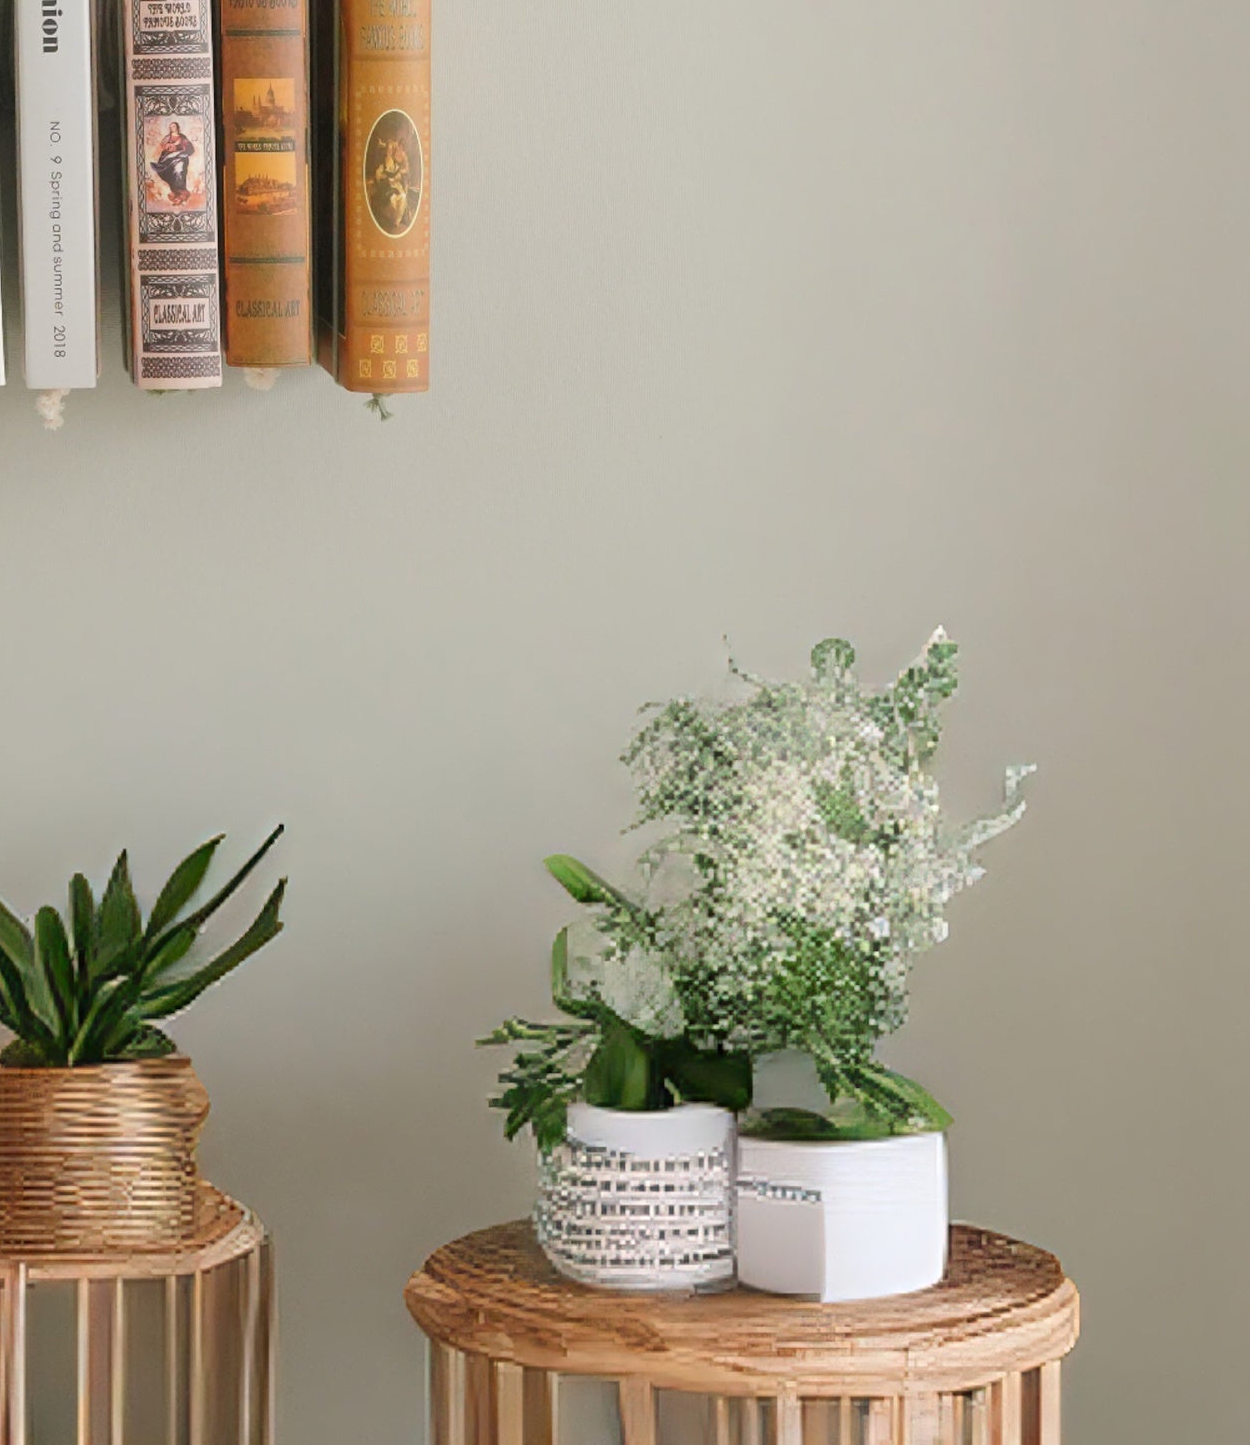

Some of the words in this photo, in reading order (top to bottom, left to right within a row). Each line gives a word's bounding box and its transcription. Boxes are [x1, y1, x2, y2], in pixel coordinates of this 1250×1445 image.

[49, 121, 61, 147] NO.
[50, 155, 63, 165] 9
[48, 171, 63, 220] Spring
[52, 225, 64, 253] and
[53, 257, 64, 317] summer
[153, 304, 191, 324] CLASSICAL
[192, 303, 206, 323] ART
[236, 299, 283, 319] CLASSICAL
[284, 299, 301, 318] ART
[53, 326, 67, 358] 2018
